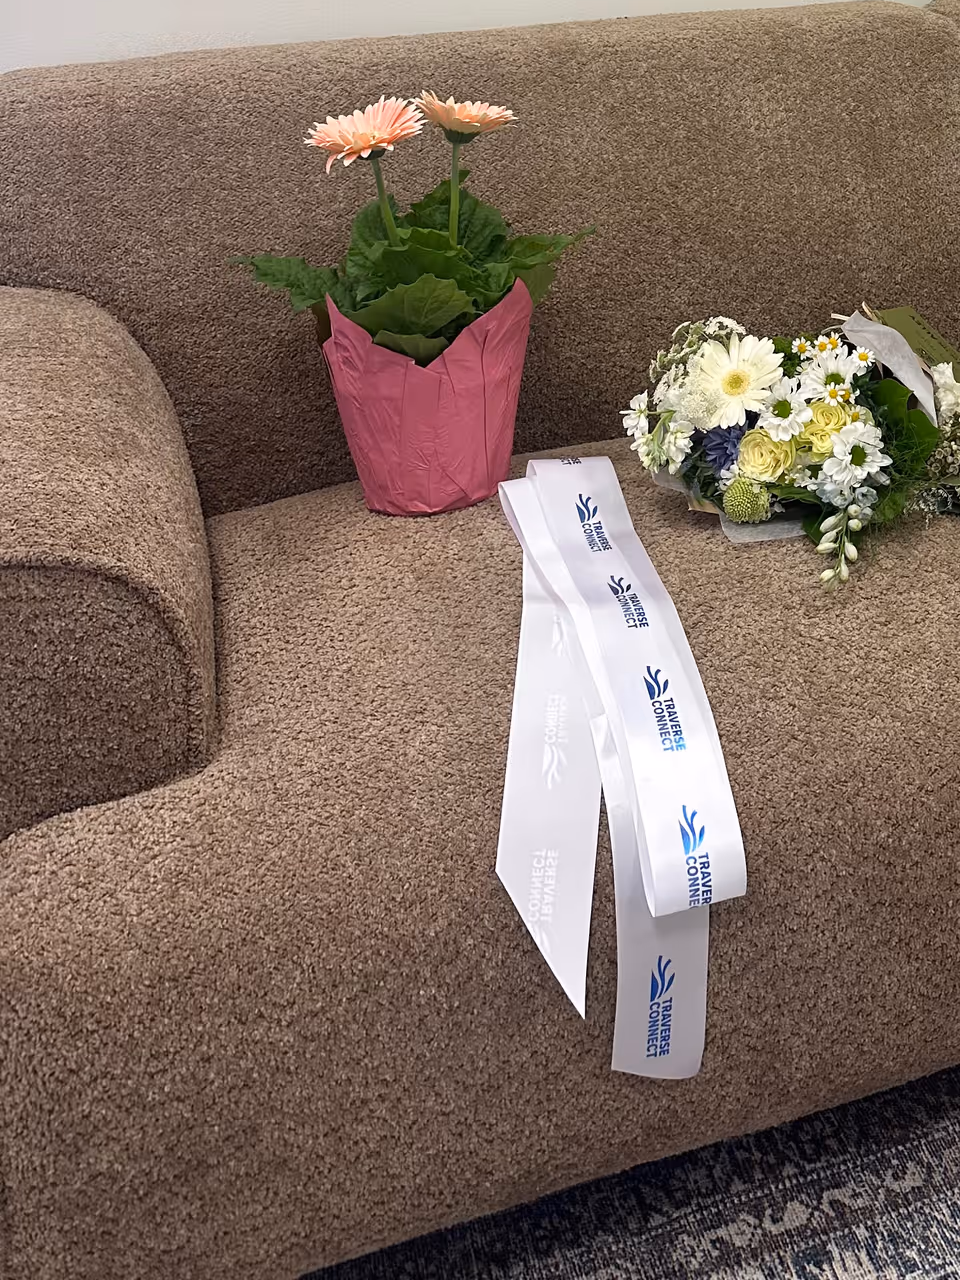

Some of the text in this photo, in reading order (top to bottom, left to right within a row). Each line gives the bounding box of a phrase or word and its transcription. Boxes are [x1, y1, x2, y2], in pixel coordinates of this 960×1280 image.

[581, 523, 602, 553] CONNECT
[592, 520, 613, 551] TRAVERSE
[615, 594, 638, 629] CONNECT
[626, 592, 650, 628] TRAVERSE
[651, 700, 675, 752] CONNECT
[663, 697, 687, 751] TRAVERSE
[685, 855, 700, 909] CONNE
[646, 1001, 661, 1058] CONNECT
[659, 996, 673, 1057] TRAVERSE
